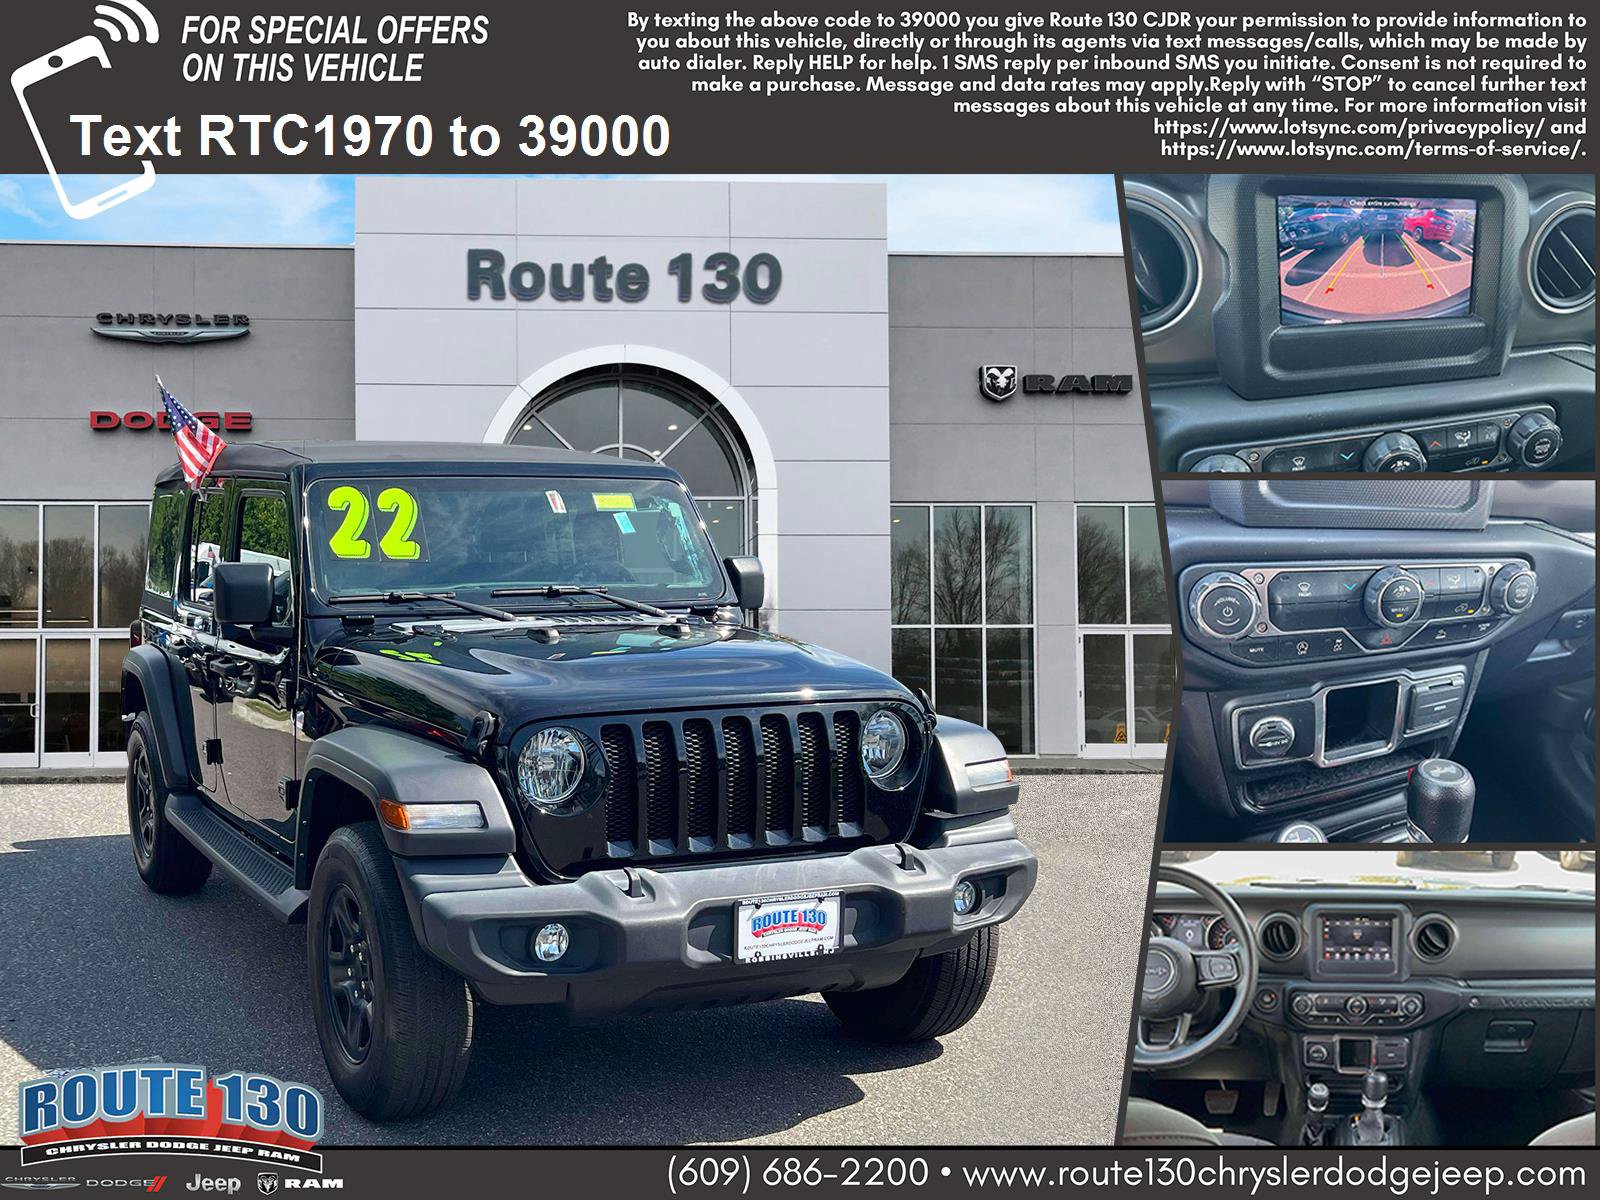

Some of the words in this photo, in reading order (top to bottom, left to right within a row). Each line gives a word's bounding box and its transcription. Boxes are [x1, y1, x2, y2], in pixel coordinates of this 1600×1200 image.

[467, 248, 650, 303] Route
[668, 251, 782, 304] 130
[96, 312, 250, 326] CHRYSLER
[1022, 374, 1134, 394] RAM
[327, 485, 420, 560] 22
[752, 909, 798, 932] ROUTE
[803, 908, 827, 925] 130
